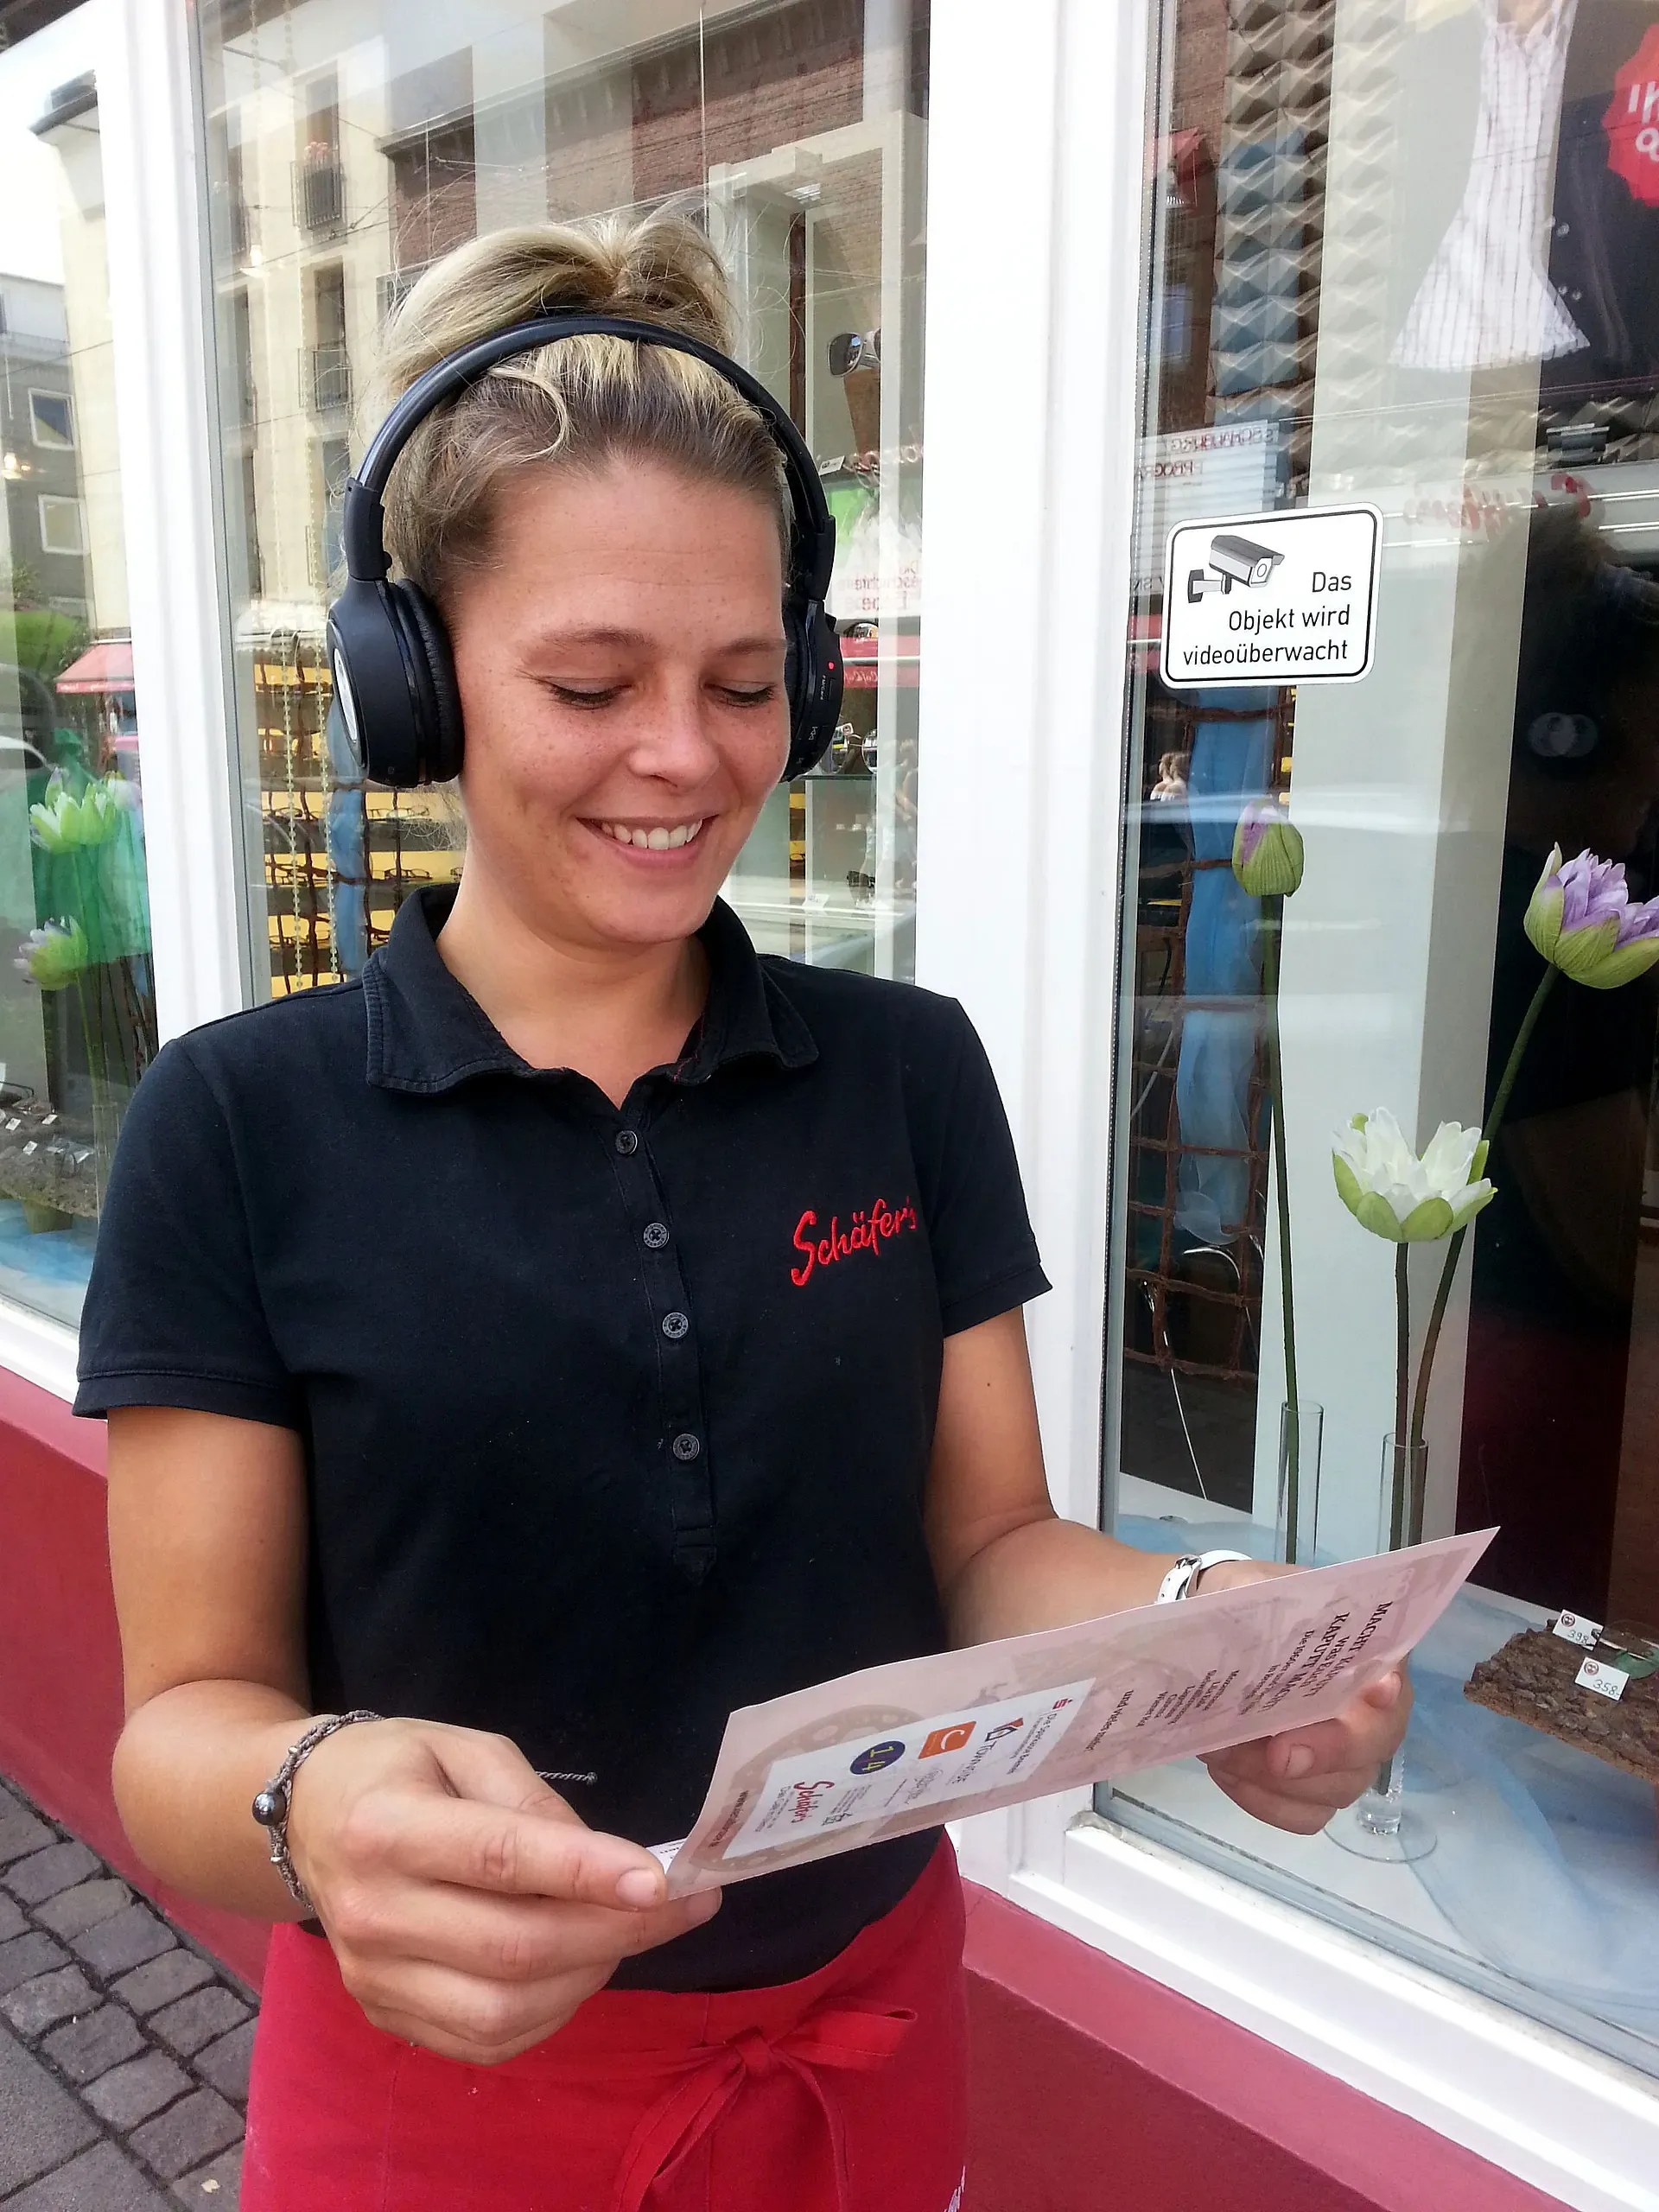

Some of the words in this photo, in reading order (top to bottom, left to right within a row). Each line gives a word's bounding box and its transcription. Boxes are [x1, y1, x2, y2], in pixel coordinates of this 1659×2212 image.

[1312, 572, 1352, 593] Das
[1229, 608, 1294, 635] Objekt
[1302, 604, 1350, 627] wird
[1183, 639, 1348, 665] videoüberwacht
[791, 1196, 917, 1286] Schäfer's
[1296, 1629, 1315, 1645] Die
[1300, 1611, 1351, 1669] KAPUTT
[1346, 1600, 1395, 1652] MACHT
[1323, 1635, 1351, 1661] was
[1297, 1659, 1336, 1688] Euch
[1300, 1655, 1357, 1699] KAPUTT
[1116, 1689, 1135, 1707] und
